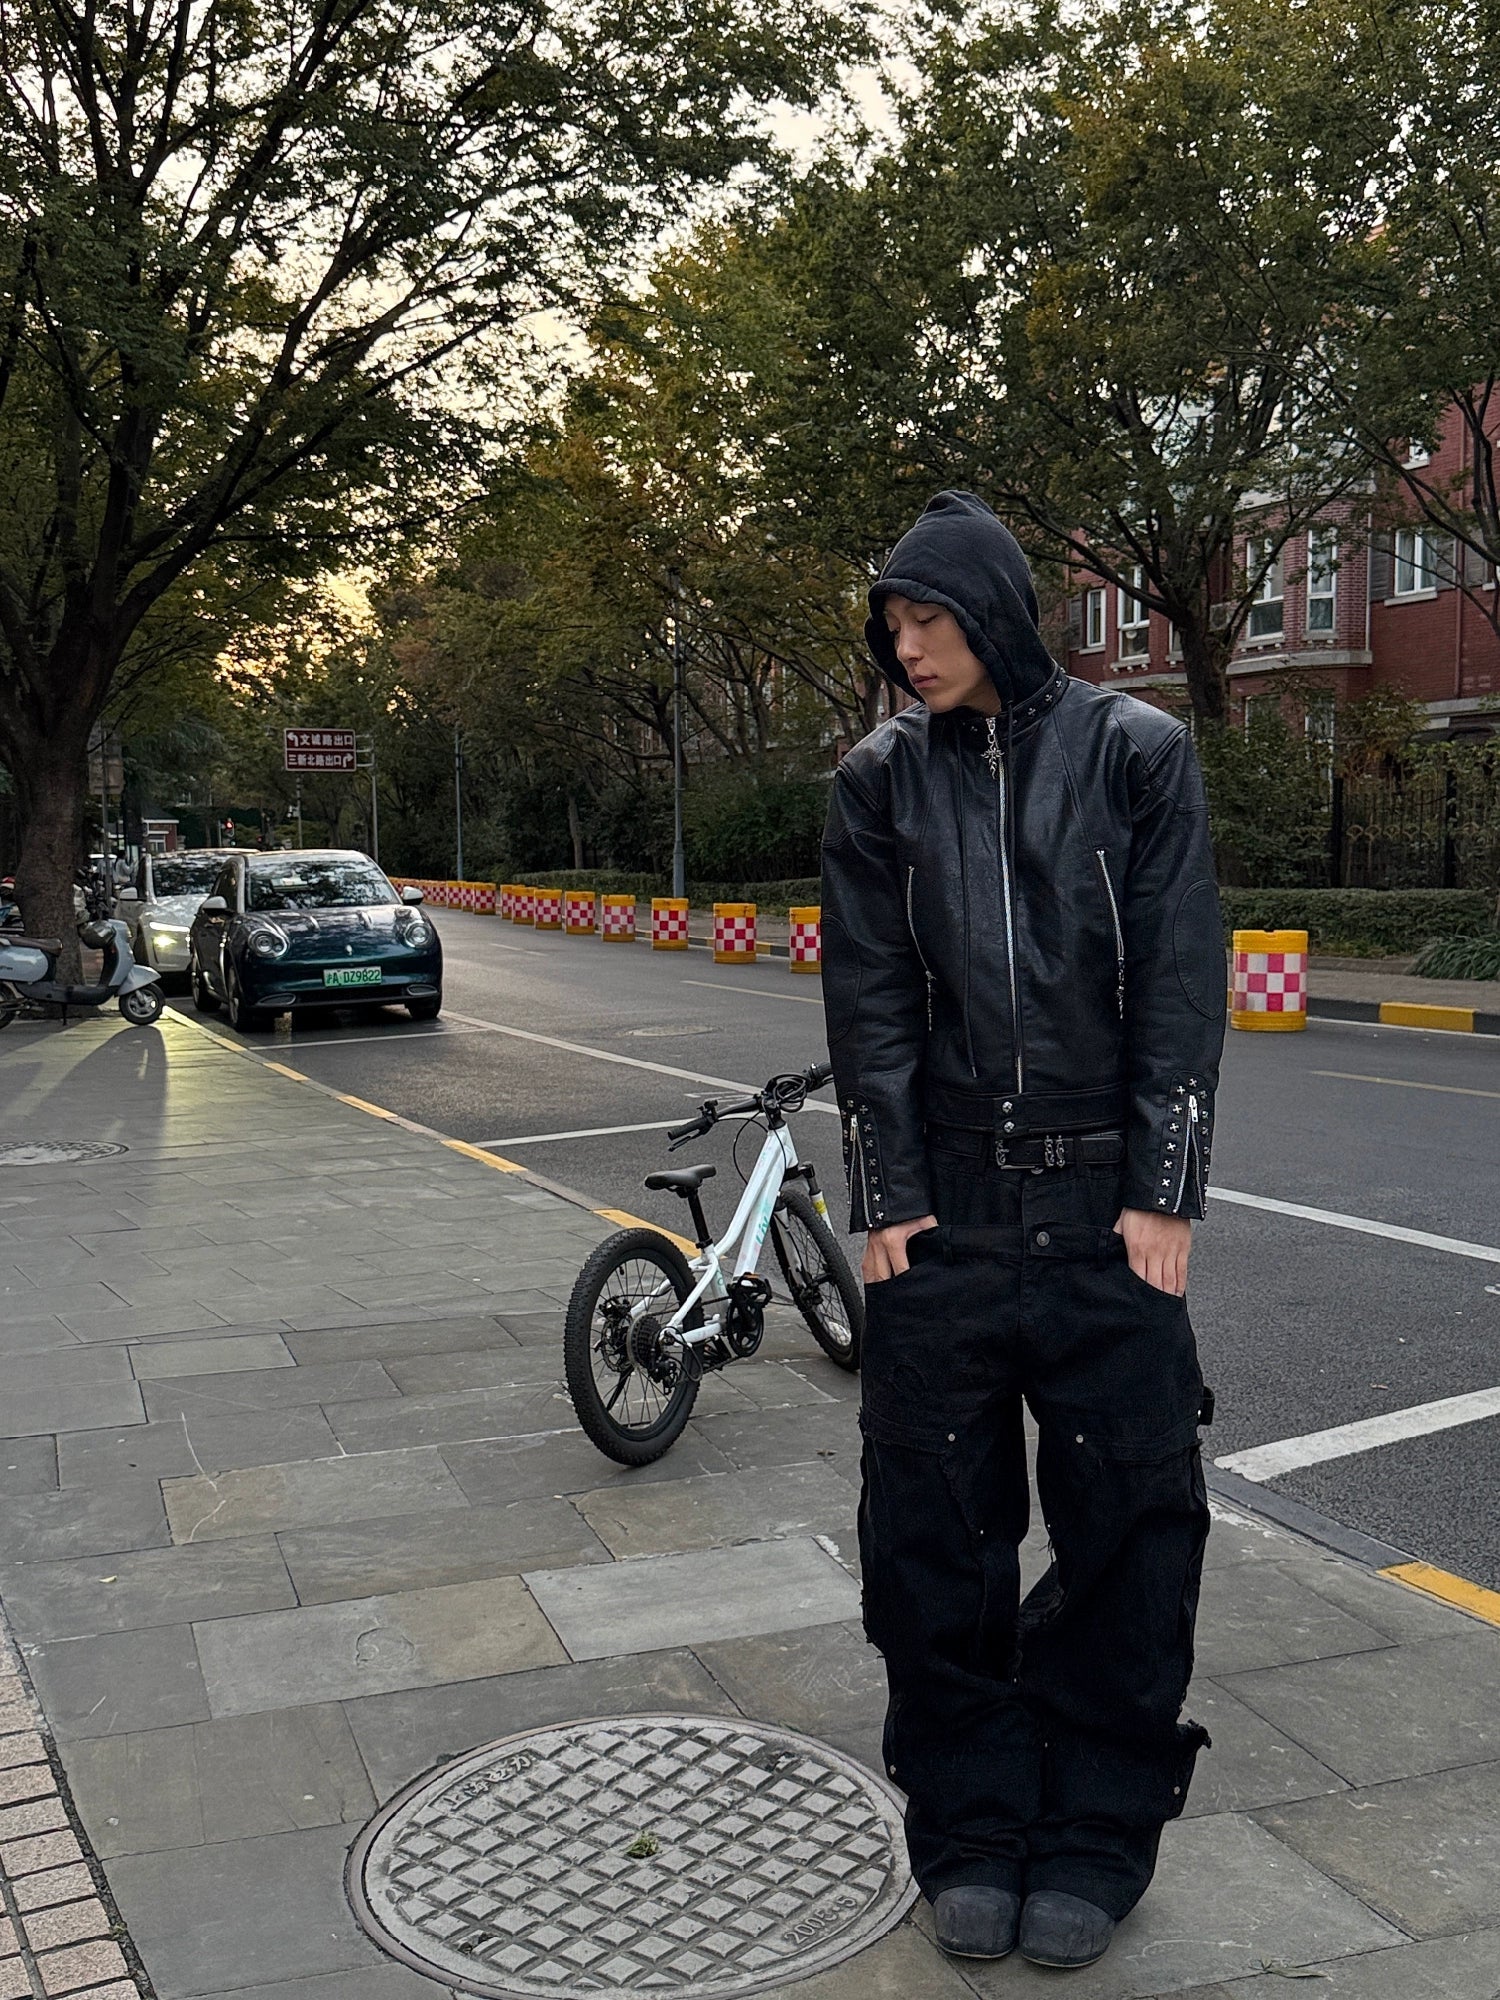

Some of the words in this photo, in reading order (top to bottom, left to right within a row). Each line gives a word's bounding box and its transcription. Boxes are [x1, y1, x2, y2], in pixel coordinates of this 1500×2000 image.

[288, 754, 342, 766] 三新北路出口
[344, 969, 381, 983] DZ9822
